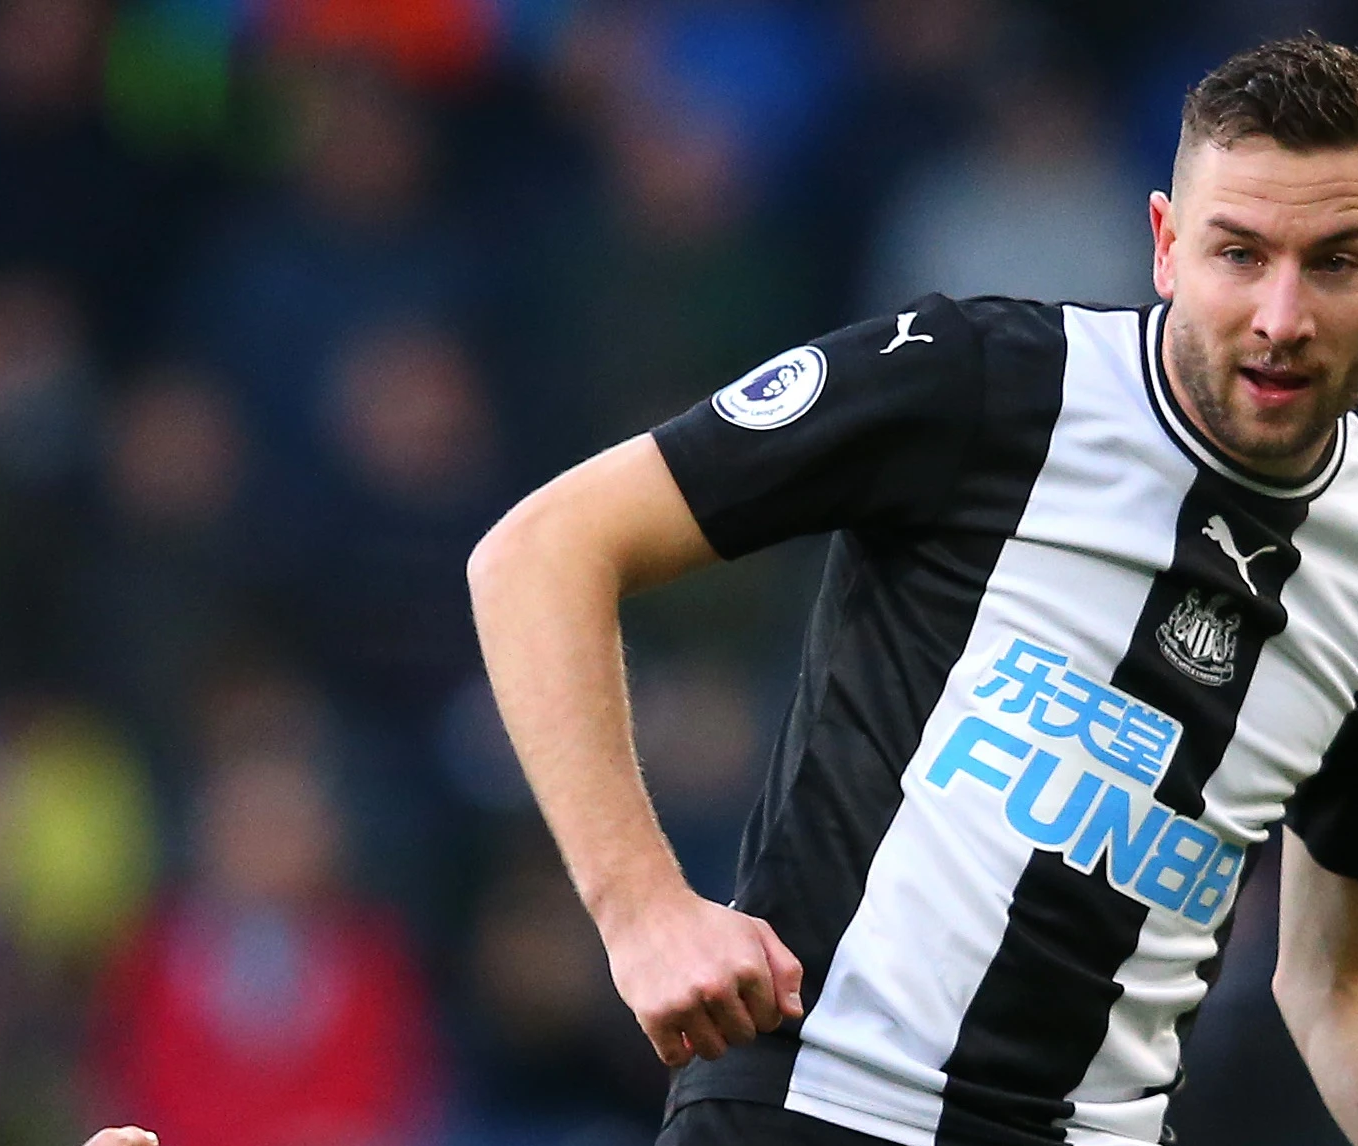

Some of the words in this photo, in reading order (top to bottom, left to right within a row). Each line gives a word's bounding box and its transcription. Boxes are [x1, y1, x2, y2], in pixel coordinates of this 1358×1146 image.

[973, 638, 1176, 787] 乐天堂
[925, 715, 1243, 926] FUN88
